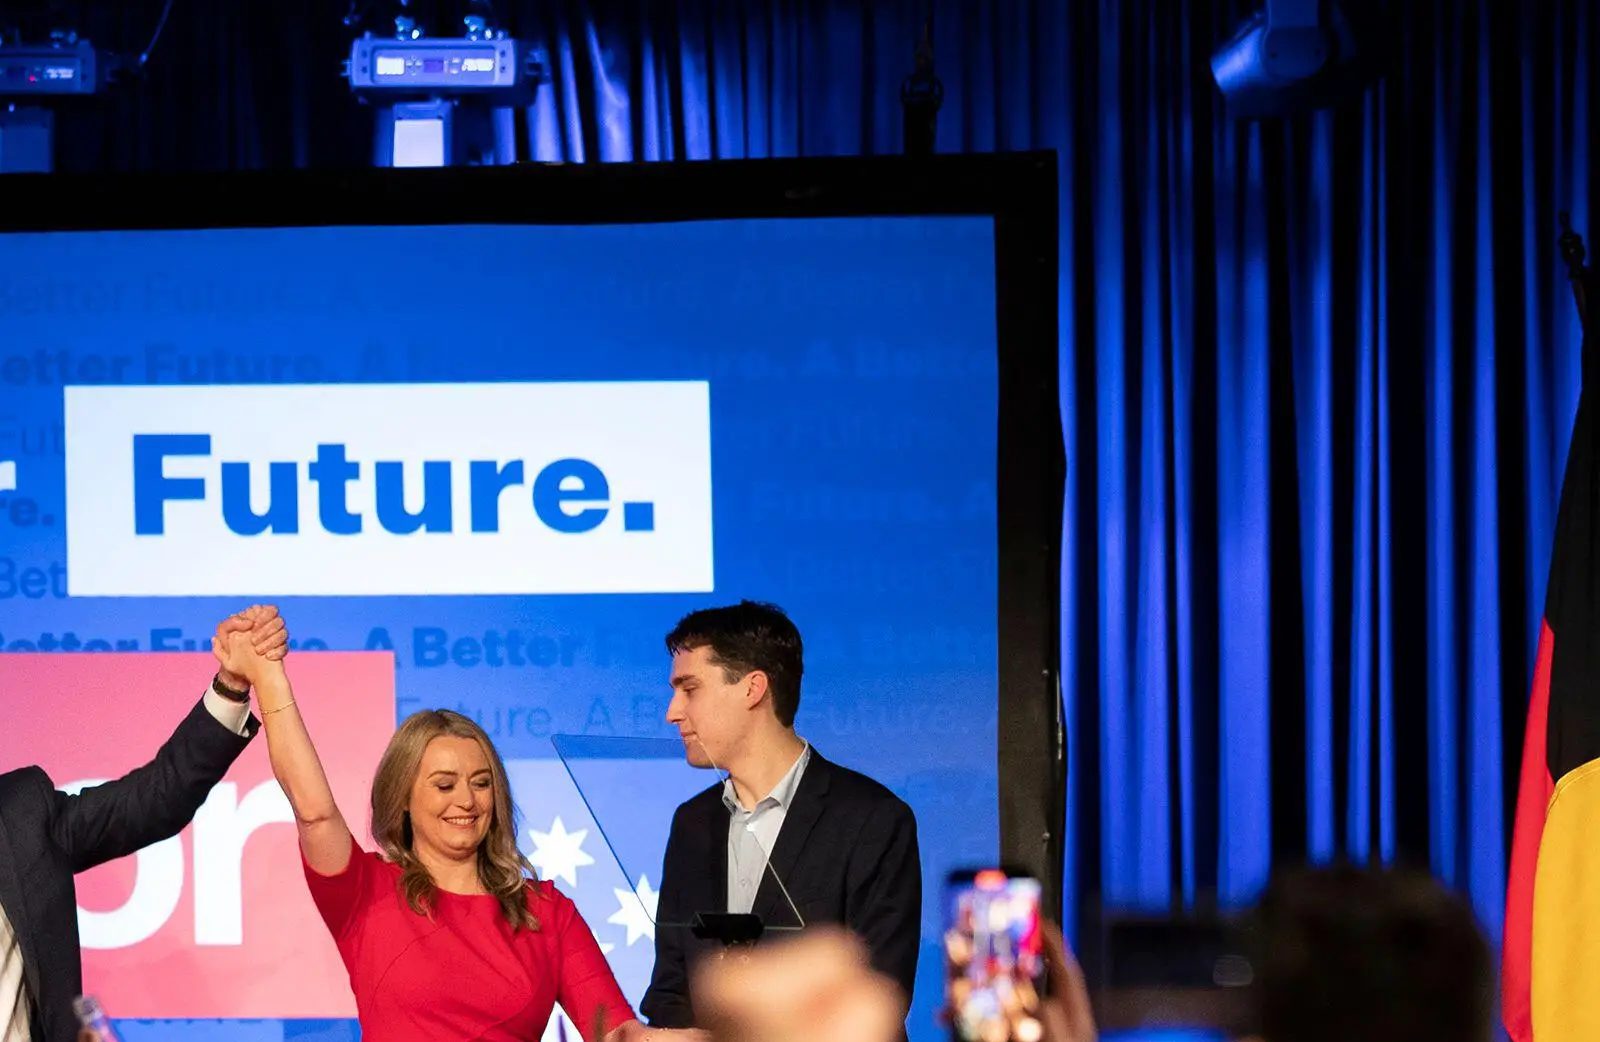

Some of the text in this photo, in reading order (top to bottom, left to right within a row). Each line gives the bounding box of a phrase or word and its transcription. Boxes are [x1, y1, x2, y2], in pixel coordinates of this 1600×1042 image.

[133, 433, 655, 536] Future.
[364, 626, 402, 668] A
[411, 626, 580, 668] Better
